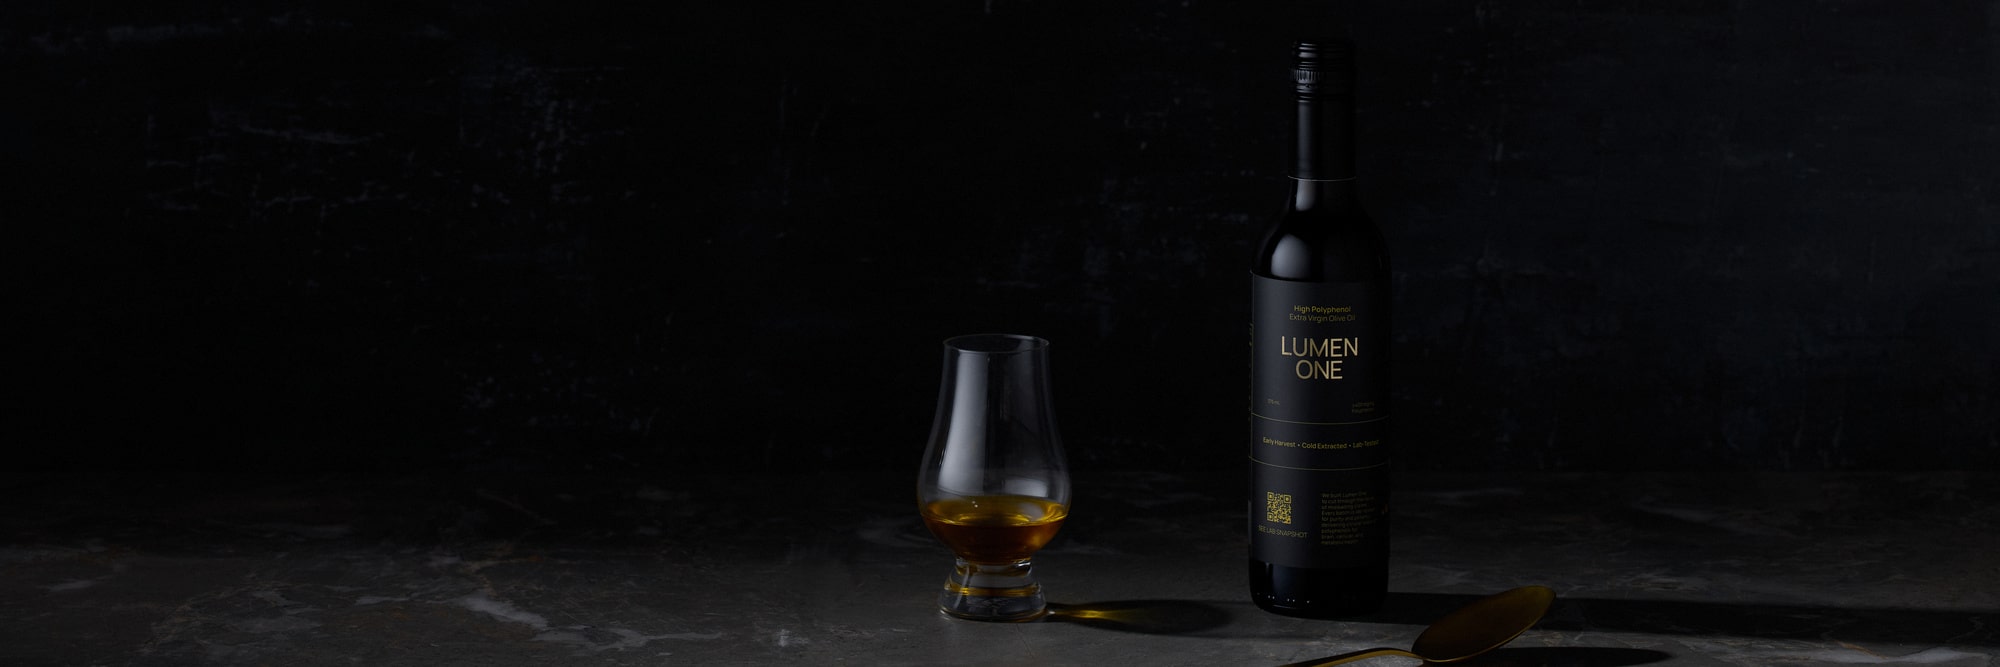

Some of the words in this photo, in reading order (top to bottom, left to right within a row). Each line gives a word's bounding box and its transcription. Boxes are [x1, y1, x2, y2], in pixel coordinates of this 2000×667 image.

[1293, 305, 1310, 314] High
[1311, 306, 1352, 316] Polyphenol
[1289, 314, 1306, 322] Extra
[1307, 314, 1328, 324] Virgin
[1281, 336, 1359, 358] LUMEN
[1295, 360, 1344, 380] ONE
